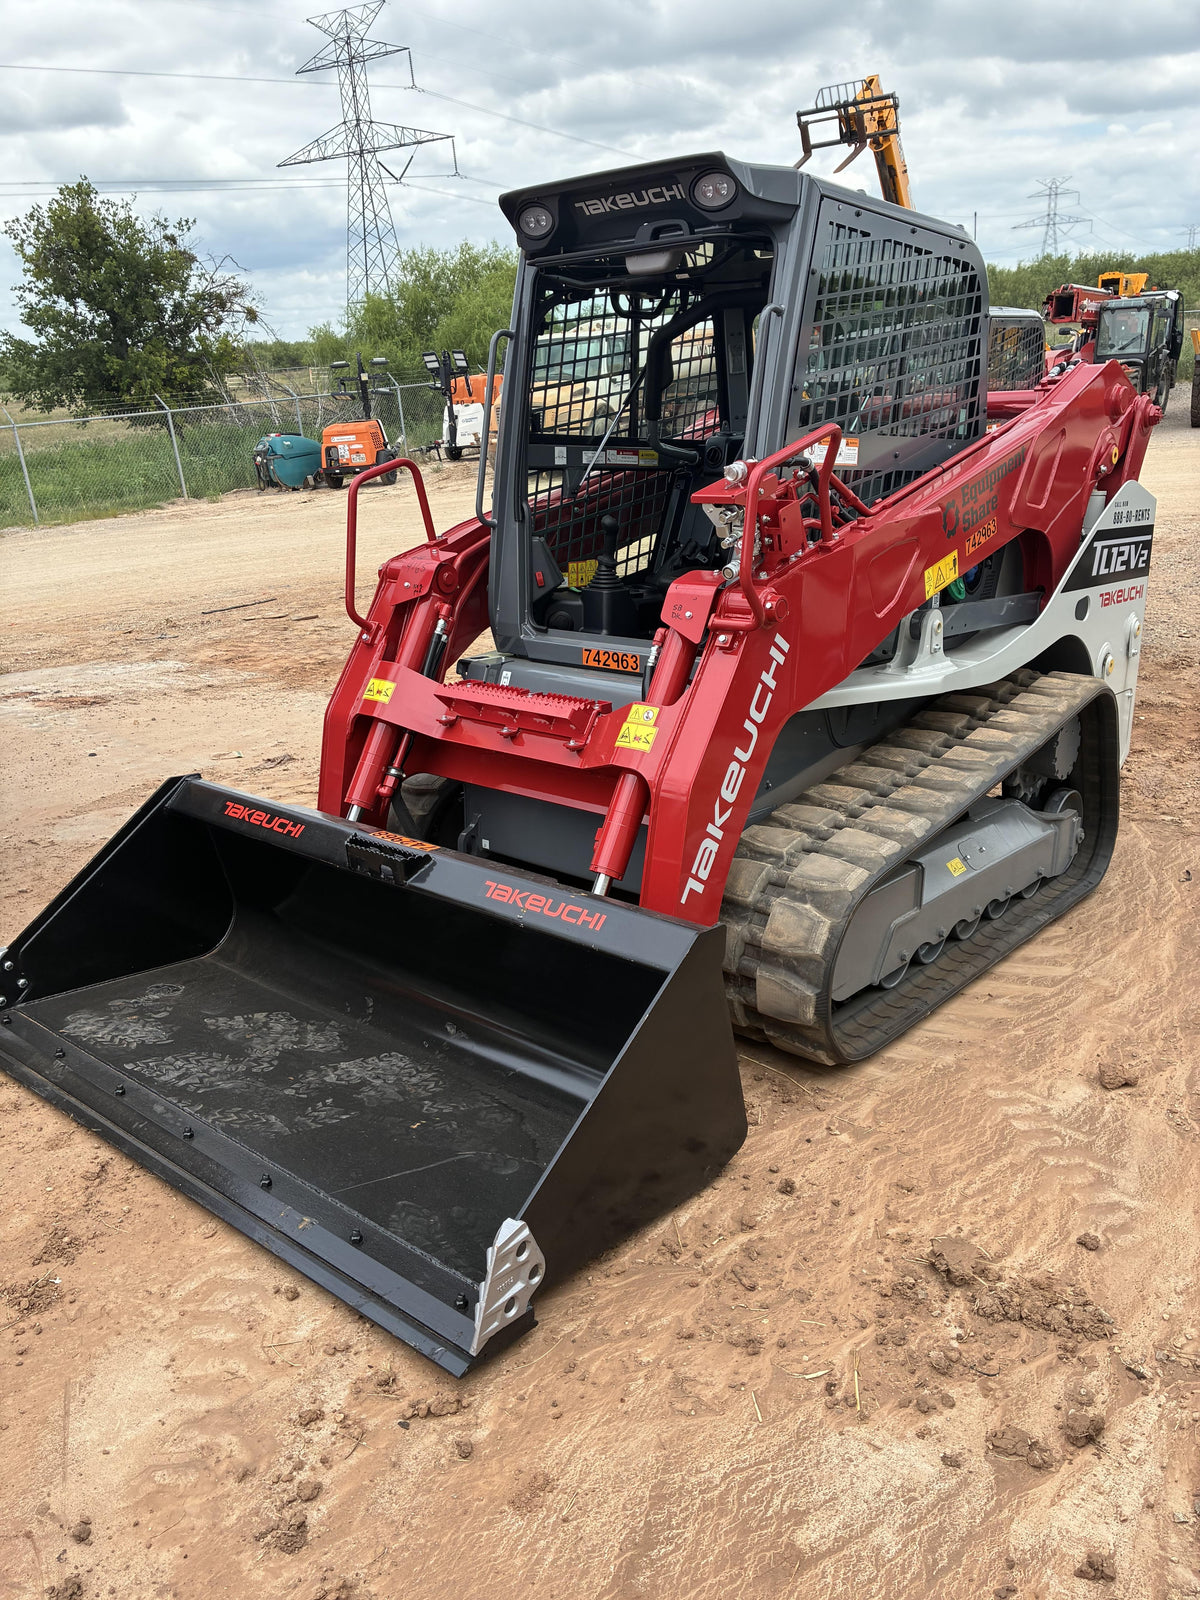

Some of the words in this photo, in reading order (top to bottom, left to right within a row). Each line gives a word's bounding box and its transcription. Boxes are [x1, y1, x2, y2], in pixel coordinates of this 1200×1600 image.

[574, 183, 686, 216] TAKEUCHI
[960, 446, 1027, 508] Equipment
[962, 493, 999, 533] Share
[1113, 508, 1151, 525] 888-80-RENTS
[966, 518, 997, 554] 742963
[1091, 534, 1152, 577] TL12V2
[1099, 584, 1144, 609] TAKEUCHI
[584, 648, 639, 671] 742963
[680, 632, 791, 905] TAKEUCHI
[224, 801, 306, 838] TAKEUCHI
[484, 881, 607, 931] TAKEUCHI
